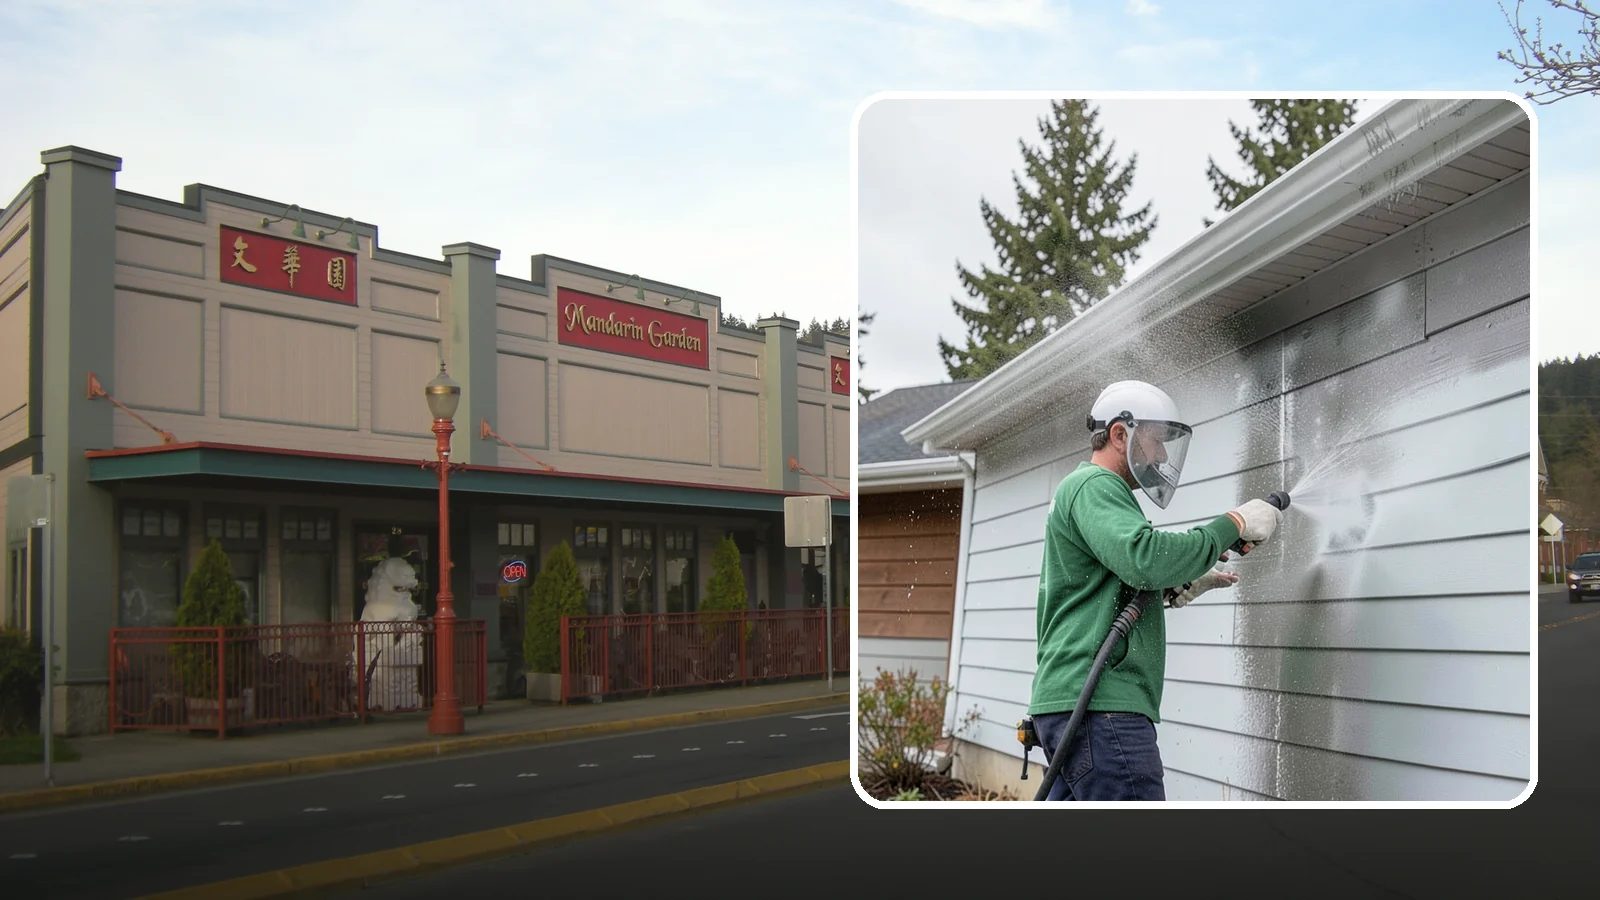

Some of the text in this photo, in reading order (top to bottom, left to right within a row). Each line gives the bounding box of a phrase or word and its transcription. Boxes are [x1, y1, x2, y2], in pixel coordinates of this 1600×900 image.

[230, 235, 347, 291] 文華園
[564, 302, 702, 352] Mandarin Garden
[503, 565, 527, 578] OPEN
